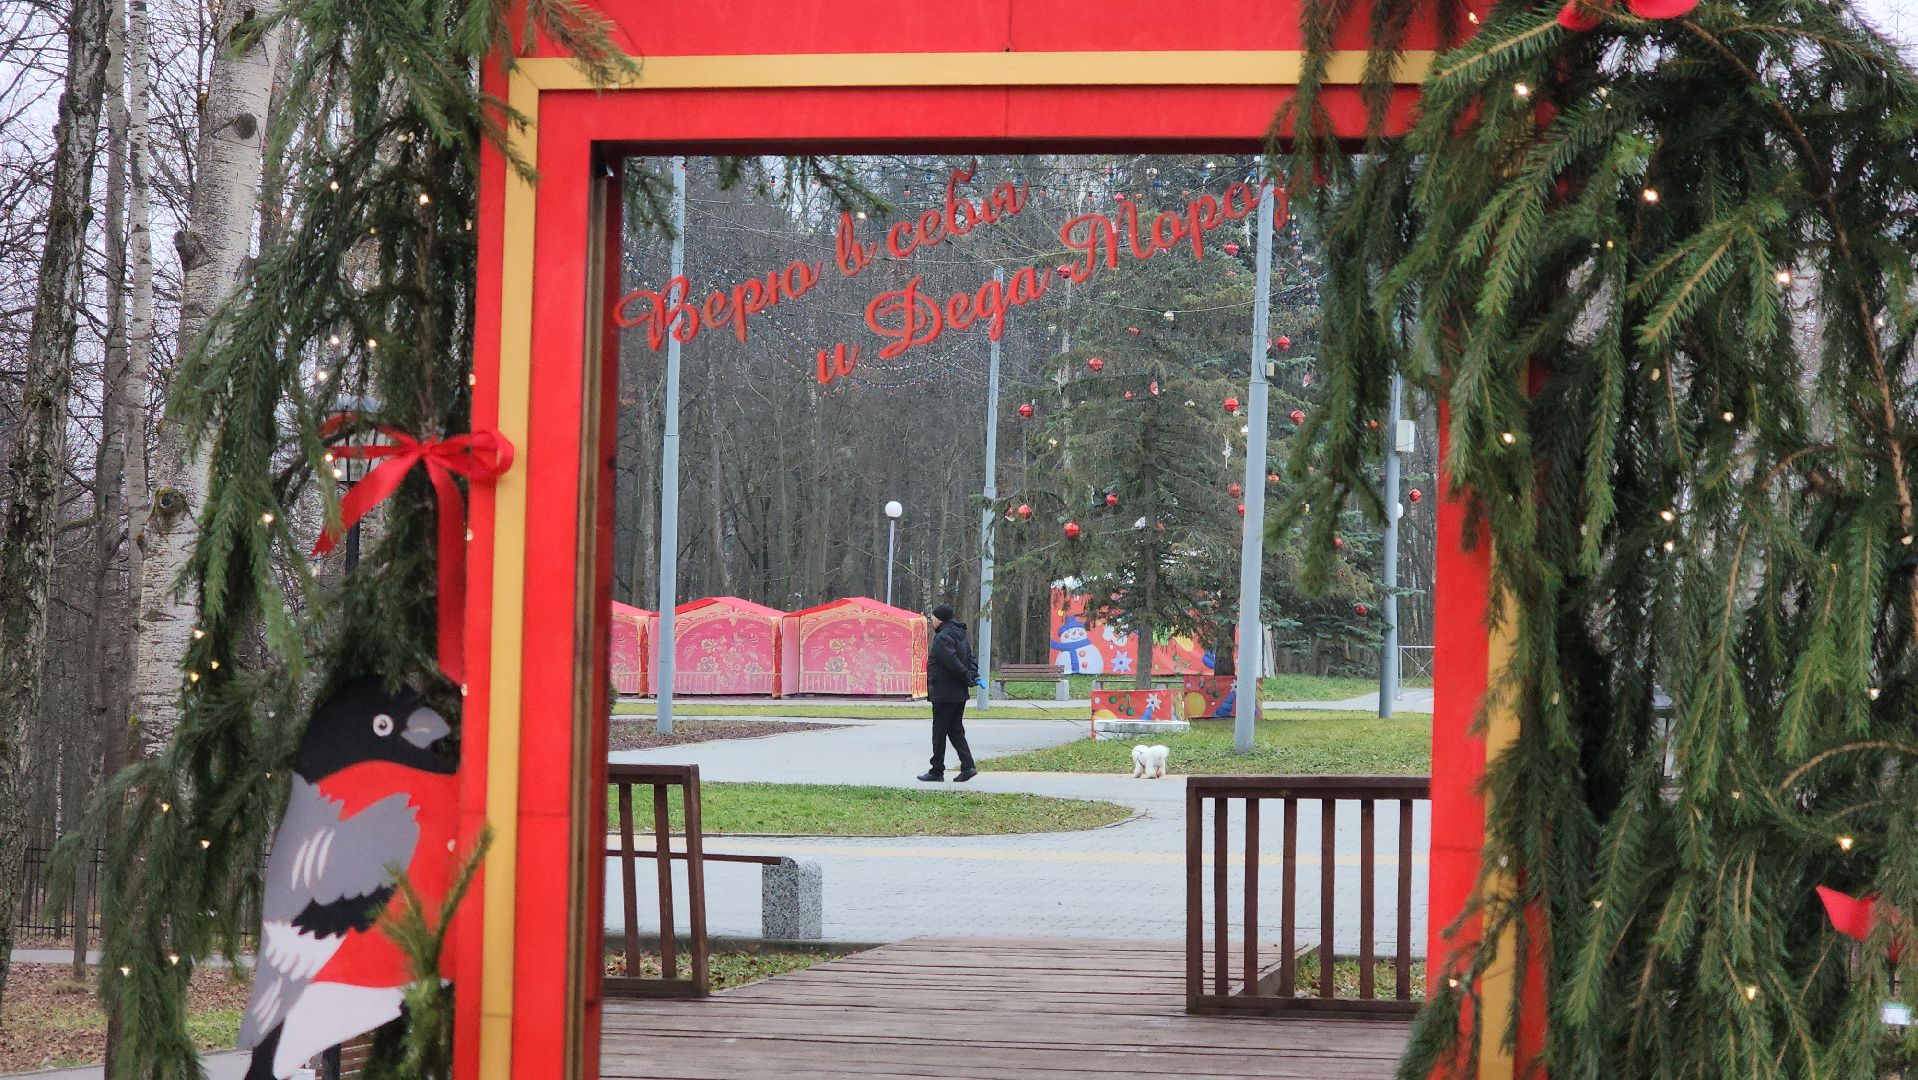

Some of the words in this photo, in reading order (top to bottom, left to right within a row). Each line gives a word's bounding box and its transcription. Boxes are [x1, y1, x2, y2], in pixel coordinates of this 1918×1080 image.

[613, 260, 823, 352] Верю
[835, 210, 877, 277] в
[887, 158, 1029, 258] себя
[816, 342, 861, 385] и
[864, 275, 1050, 360] Деда
